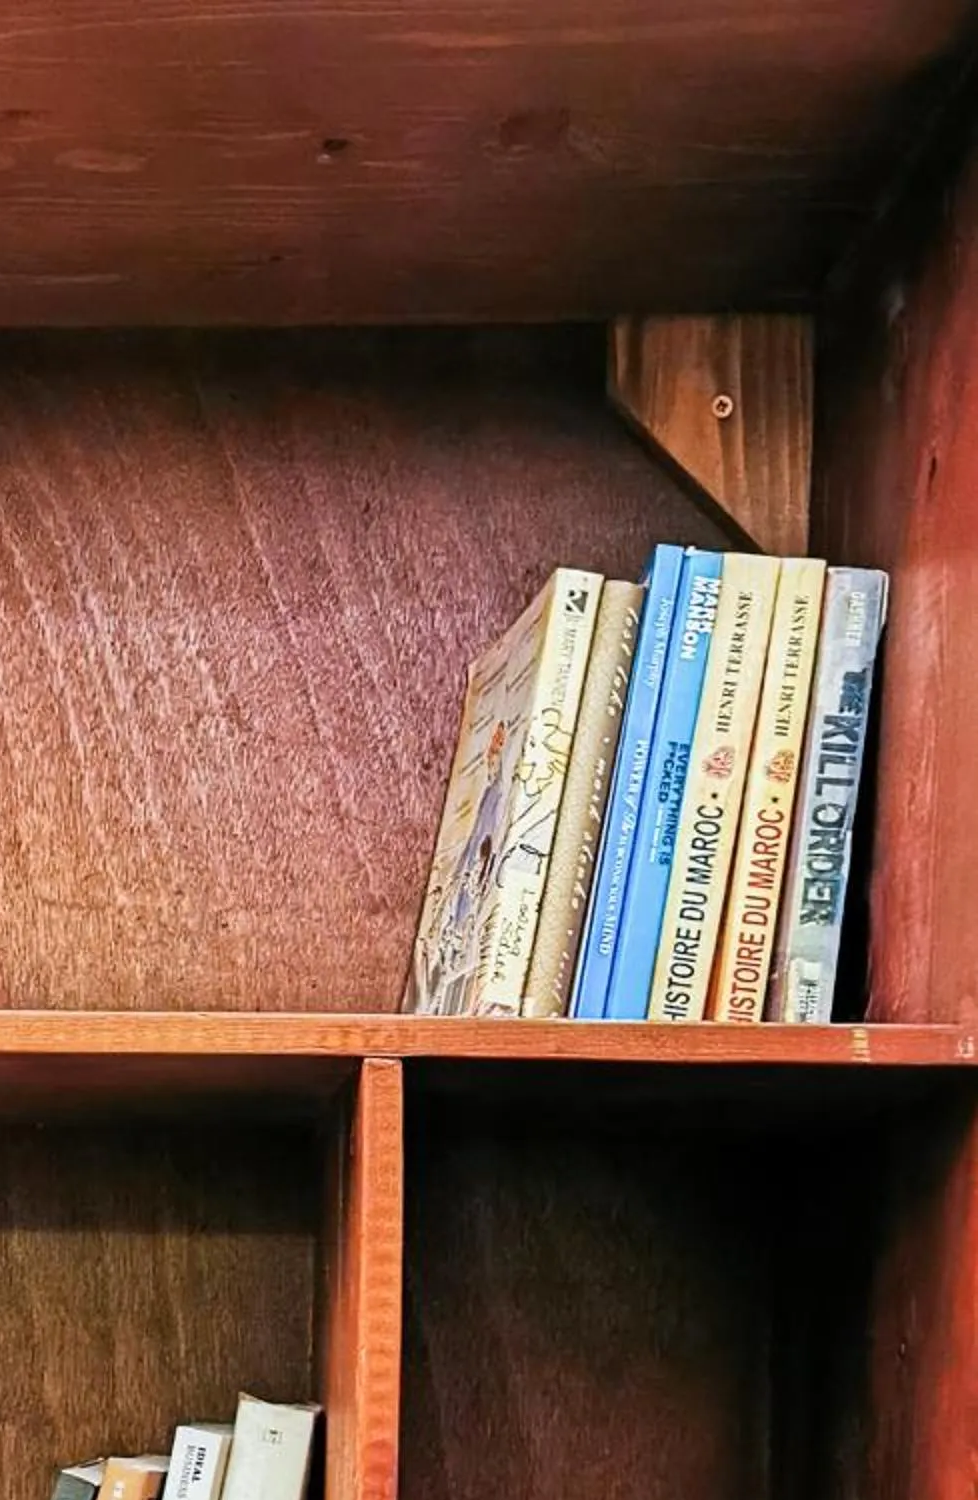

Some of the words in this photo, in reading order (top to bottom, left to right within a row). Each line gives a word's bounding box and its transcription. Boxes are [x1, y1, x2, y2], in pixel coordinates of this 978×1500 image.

[680, 576, 705, 659] MANSON
[700, 578, 721, 634] MARK
[726, 590, 754, 674] TERRASSE
[785, 594, 810, 679] TERRASSE
[716, 679, 740, 733] HENRI
[775, 682, 799, 736] HENRI
[670, 742, 690, 843] EVERYTHING
[814, 715, 860, 797] KILL
[687, 803, 723, 882] MAROC
[748, 808, 784, 885] MAROC
[798, 805, 846, 926] ORDER
[681, 882, 707, 920] DU
[743, 886, 770, 921] DU
[192, 1447, 206, 1482] IDEAL
